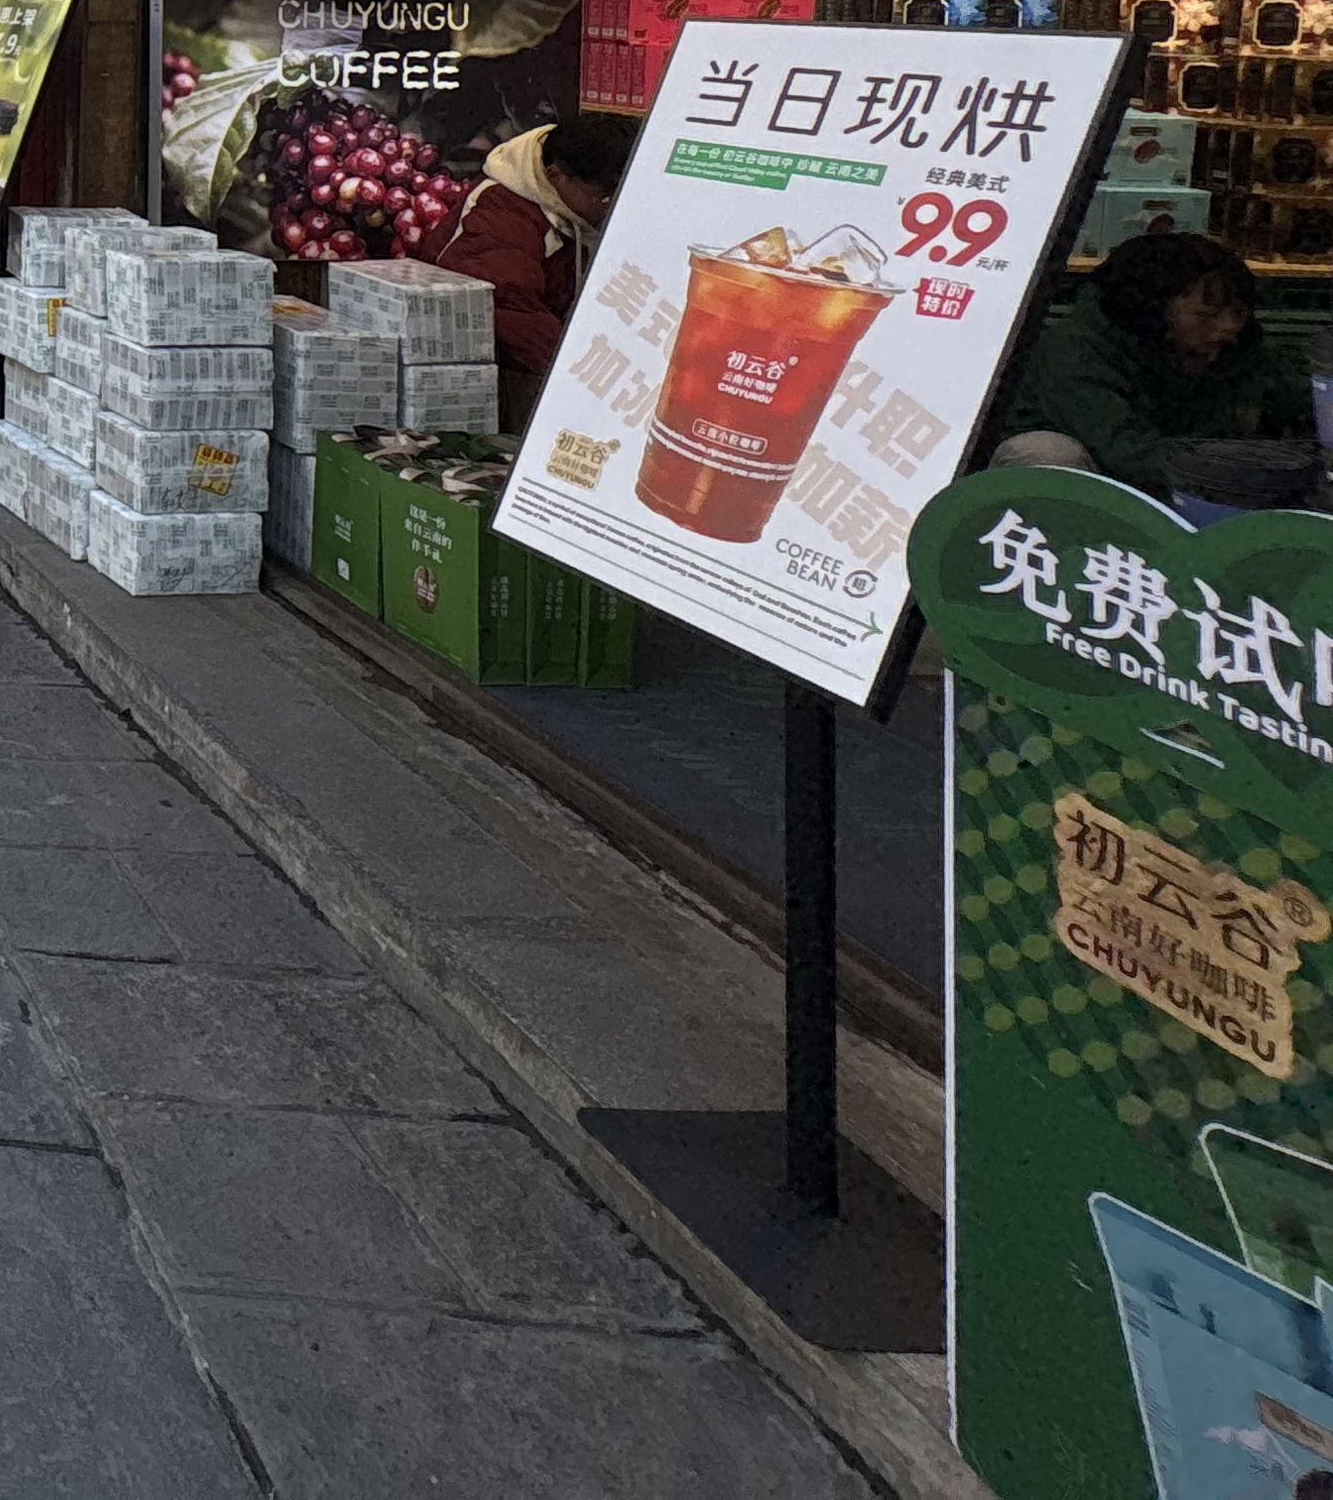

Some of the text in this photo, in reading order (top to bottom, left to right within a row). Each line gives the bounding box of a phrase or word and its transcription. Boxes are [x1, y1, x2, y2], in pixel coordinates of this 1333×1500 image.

[278, 0, 470, 31] CHUYUNGU
[276, 50, 463, 90] COFFEE
[685, 59, 1056, 163] 当日现烘
[925, 167, 1010, 194] 经典美式
[894, 191, 1008, 267] 9.9
[727, 350, 787, 380] 初云谷
[557, 431, 607, 465] 初云谷
[775, 538, 844, 576] COFFEE
[786, 559, 837, 591] BEAN
[979, 508, 1333, 724] 免费试
[1045, 622, 1112, 669] Free
[1119, 652, 1210, 711] Drink
[1066, 809, 1284, 970] 初云谷
[1067, 922, 1277, 1063] CHUYUNGU
